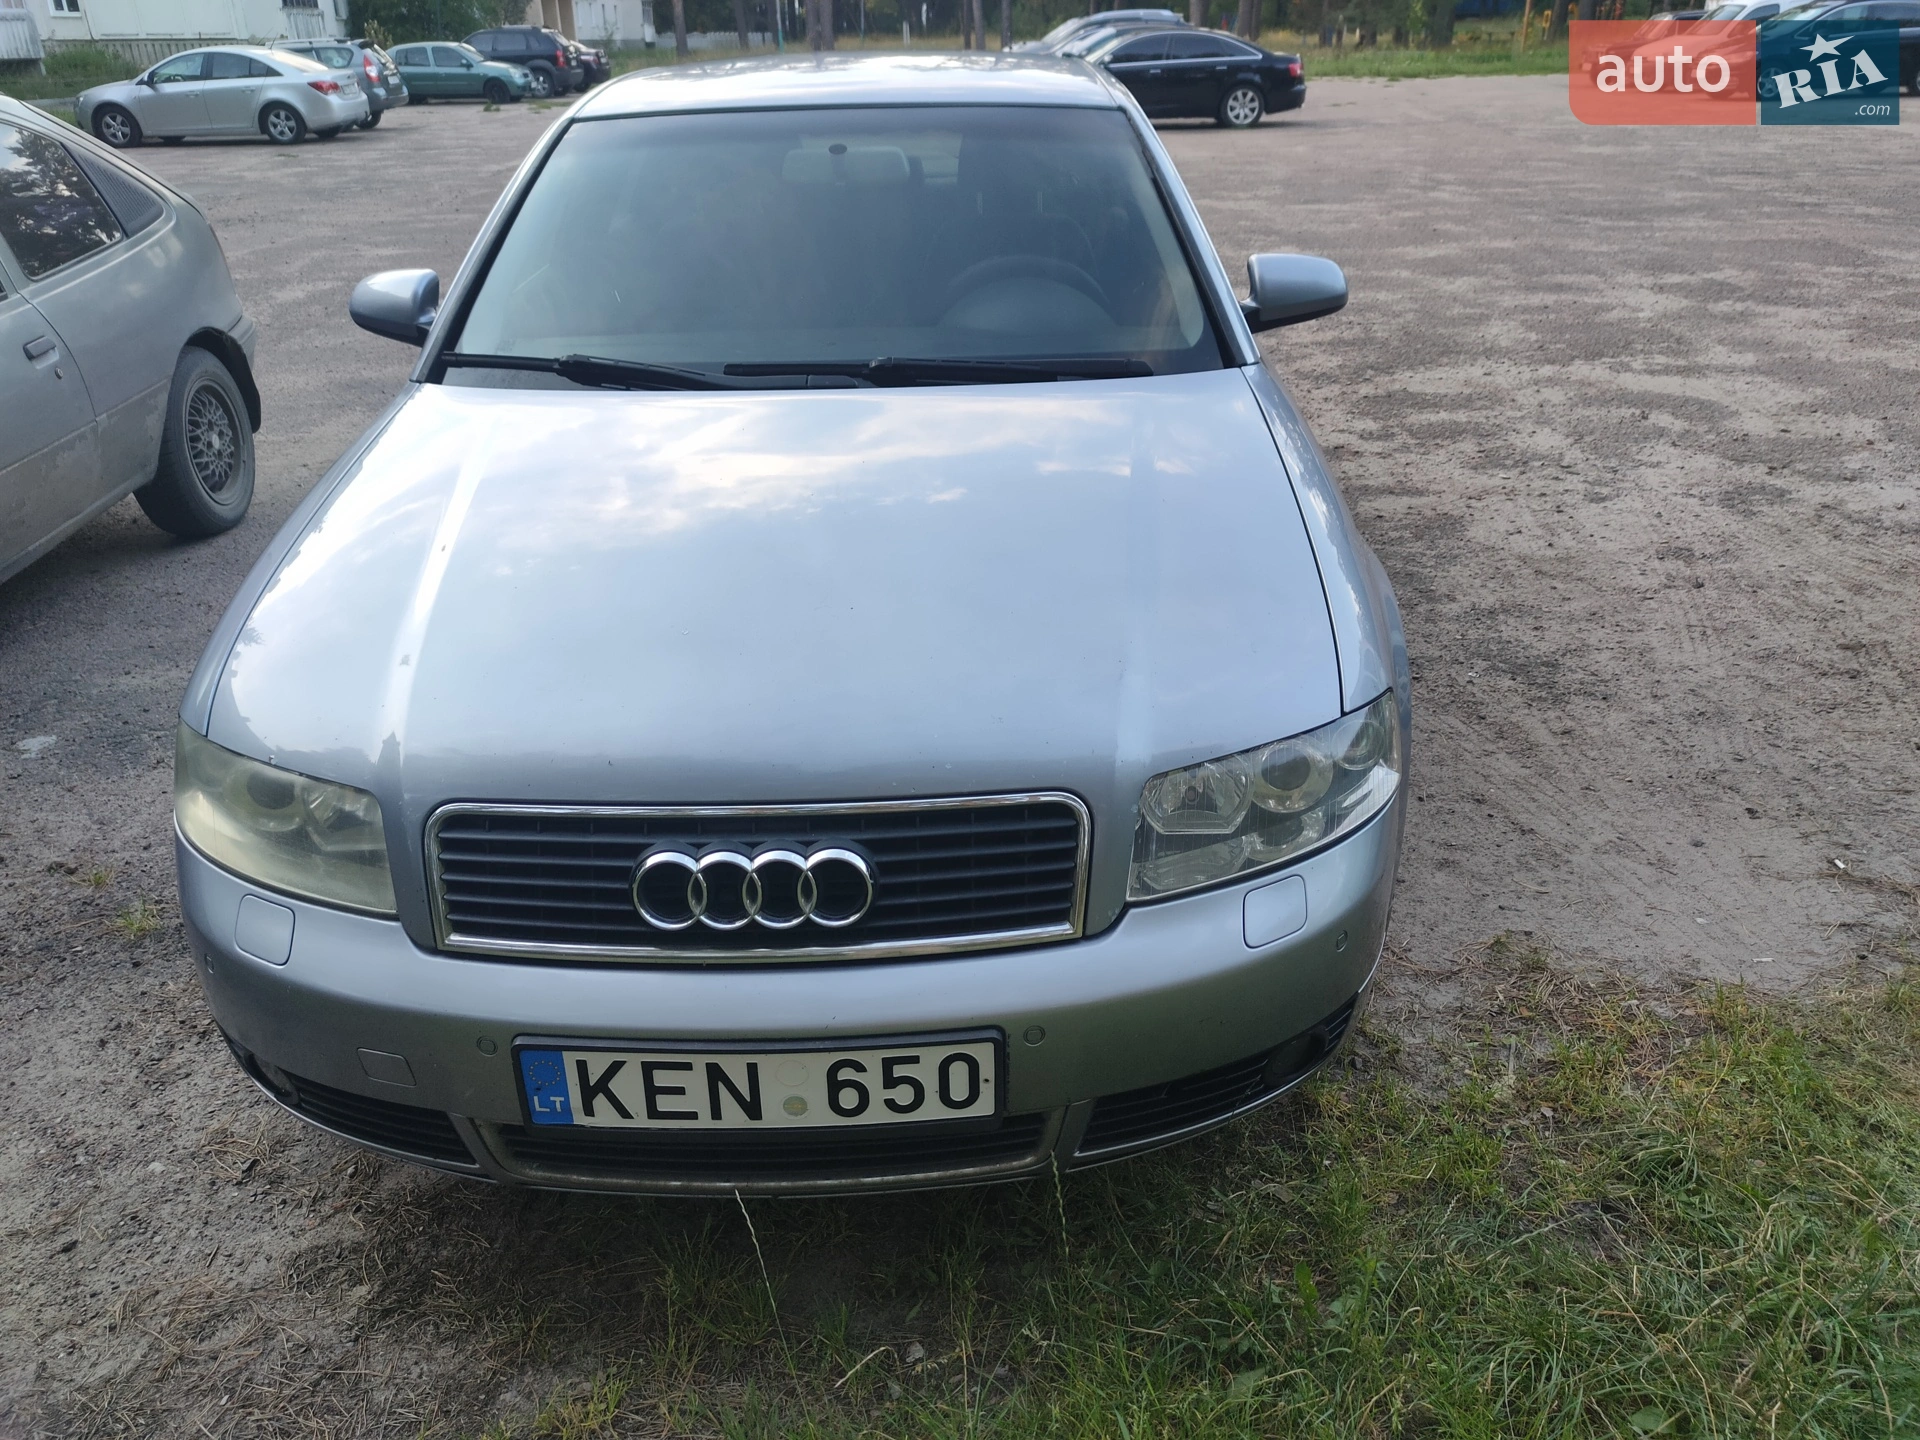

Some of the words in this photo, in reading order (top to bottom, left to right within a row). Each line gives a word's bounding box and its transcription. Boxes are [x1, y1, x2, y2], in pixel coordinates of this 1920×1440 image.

[533, 1095, 565, 1112] LT
[575, 1059, 763, 1121] KEN
[826, 1052, 981, 1118] 650
